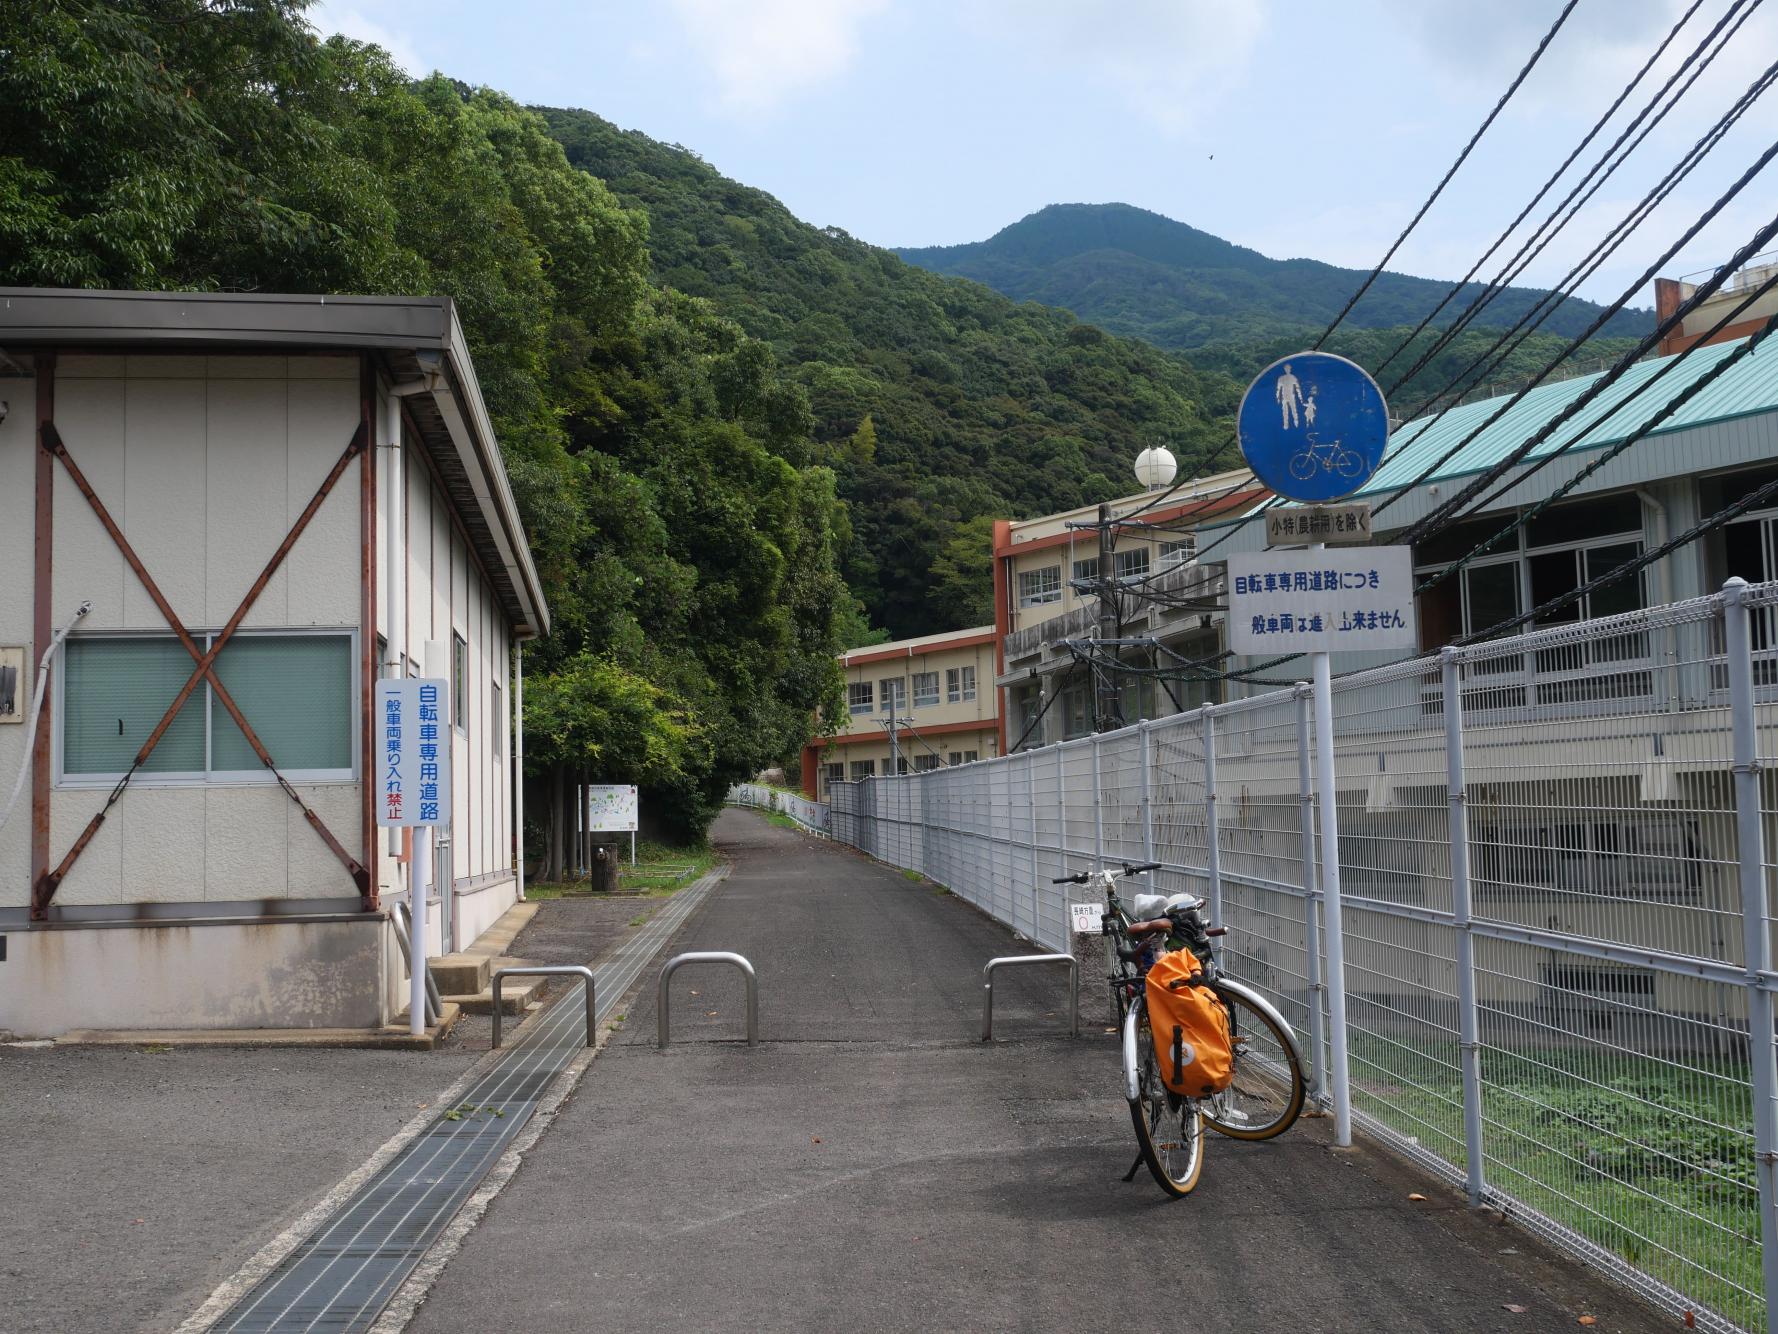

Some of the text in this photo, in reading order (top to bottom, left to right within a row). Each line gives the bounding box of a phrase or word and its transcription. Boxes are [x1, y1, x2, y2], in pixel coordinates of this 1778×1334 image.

[1235, 569, 1380, 594] 自転車専用道路につき
[385, 690, 403, 820] 一般車両乗り入れ禁止
[419, 684, 439, 821] 自転車専用道路
